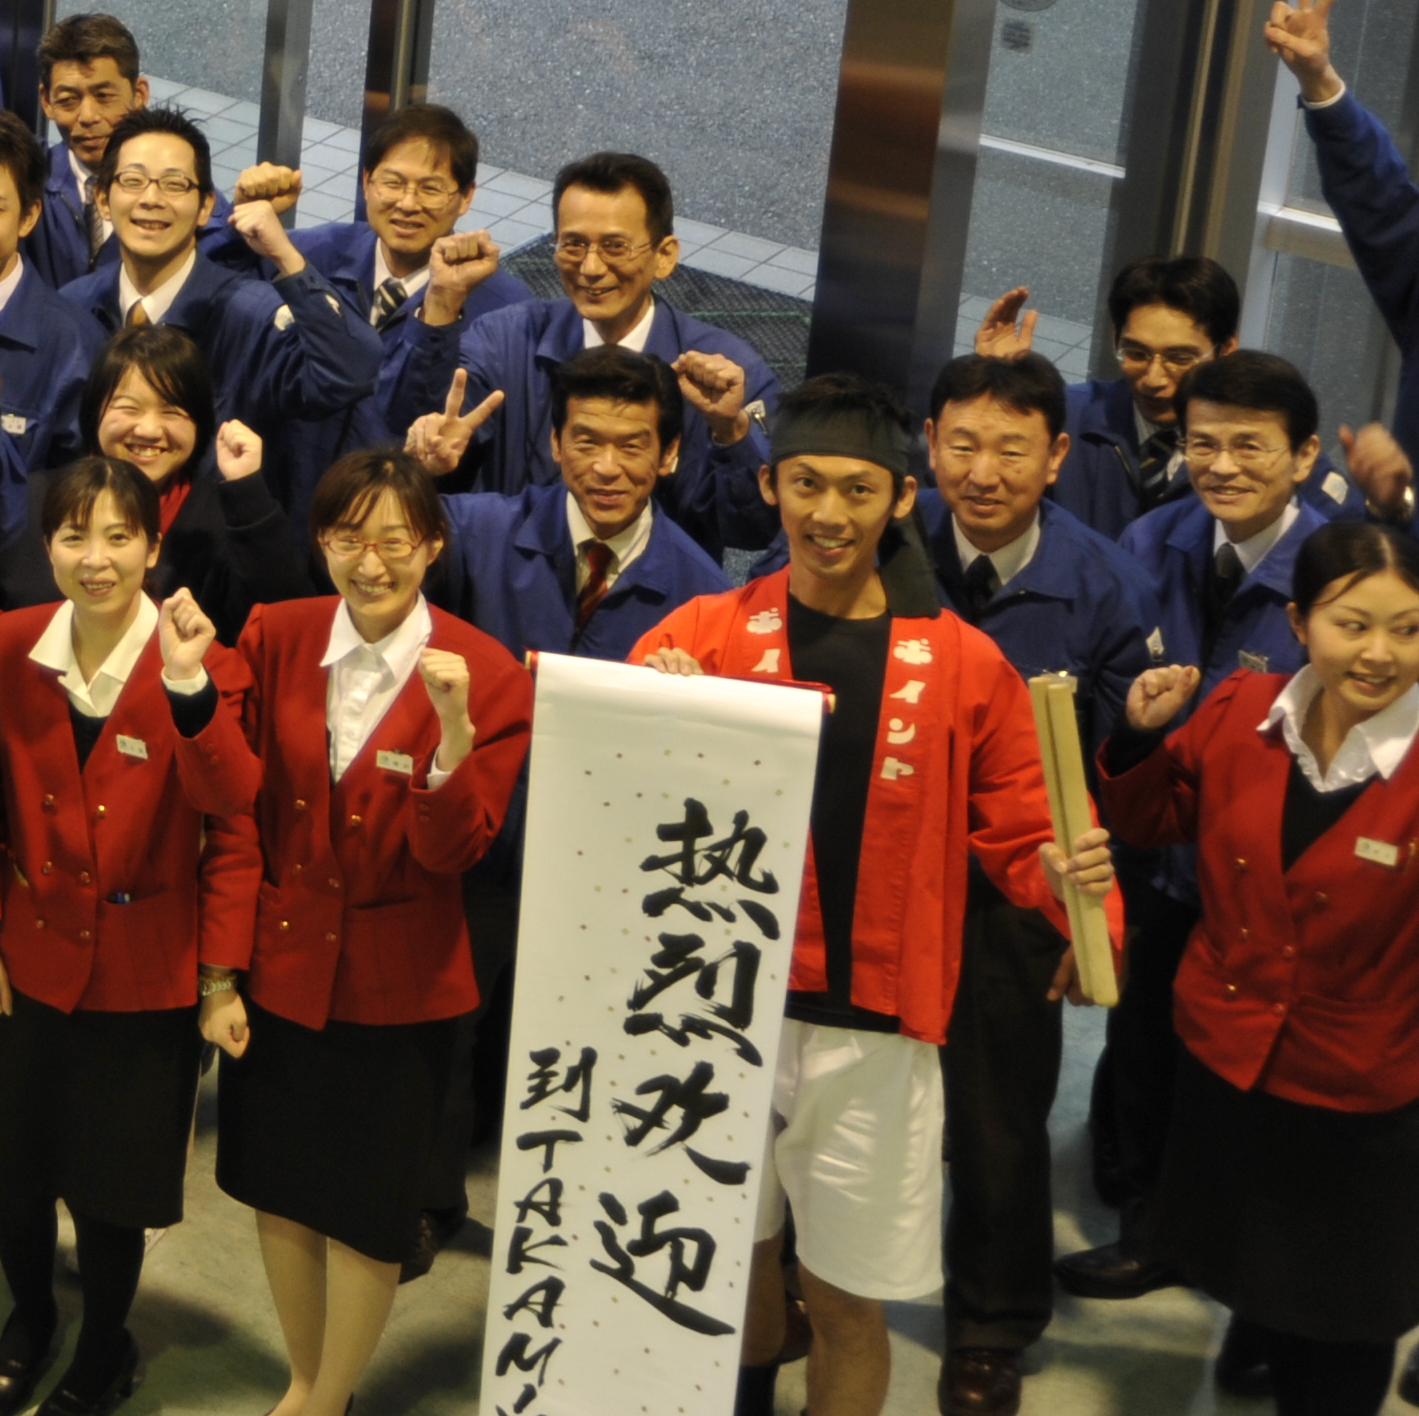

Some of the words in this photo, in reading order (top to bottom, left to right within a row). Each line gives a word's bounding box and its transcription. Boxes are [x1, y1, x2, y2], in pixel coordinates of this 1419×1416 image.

[879, 637, 933, 781] ポイント
[493, 1045, 598, 1416] 到TAKAMI
[588, 797, 780, 1337] 热烈欢迎
